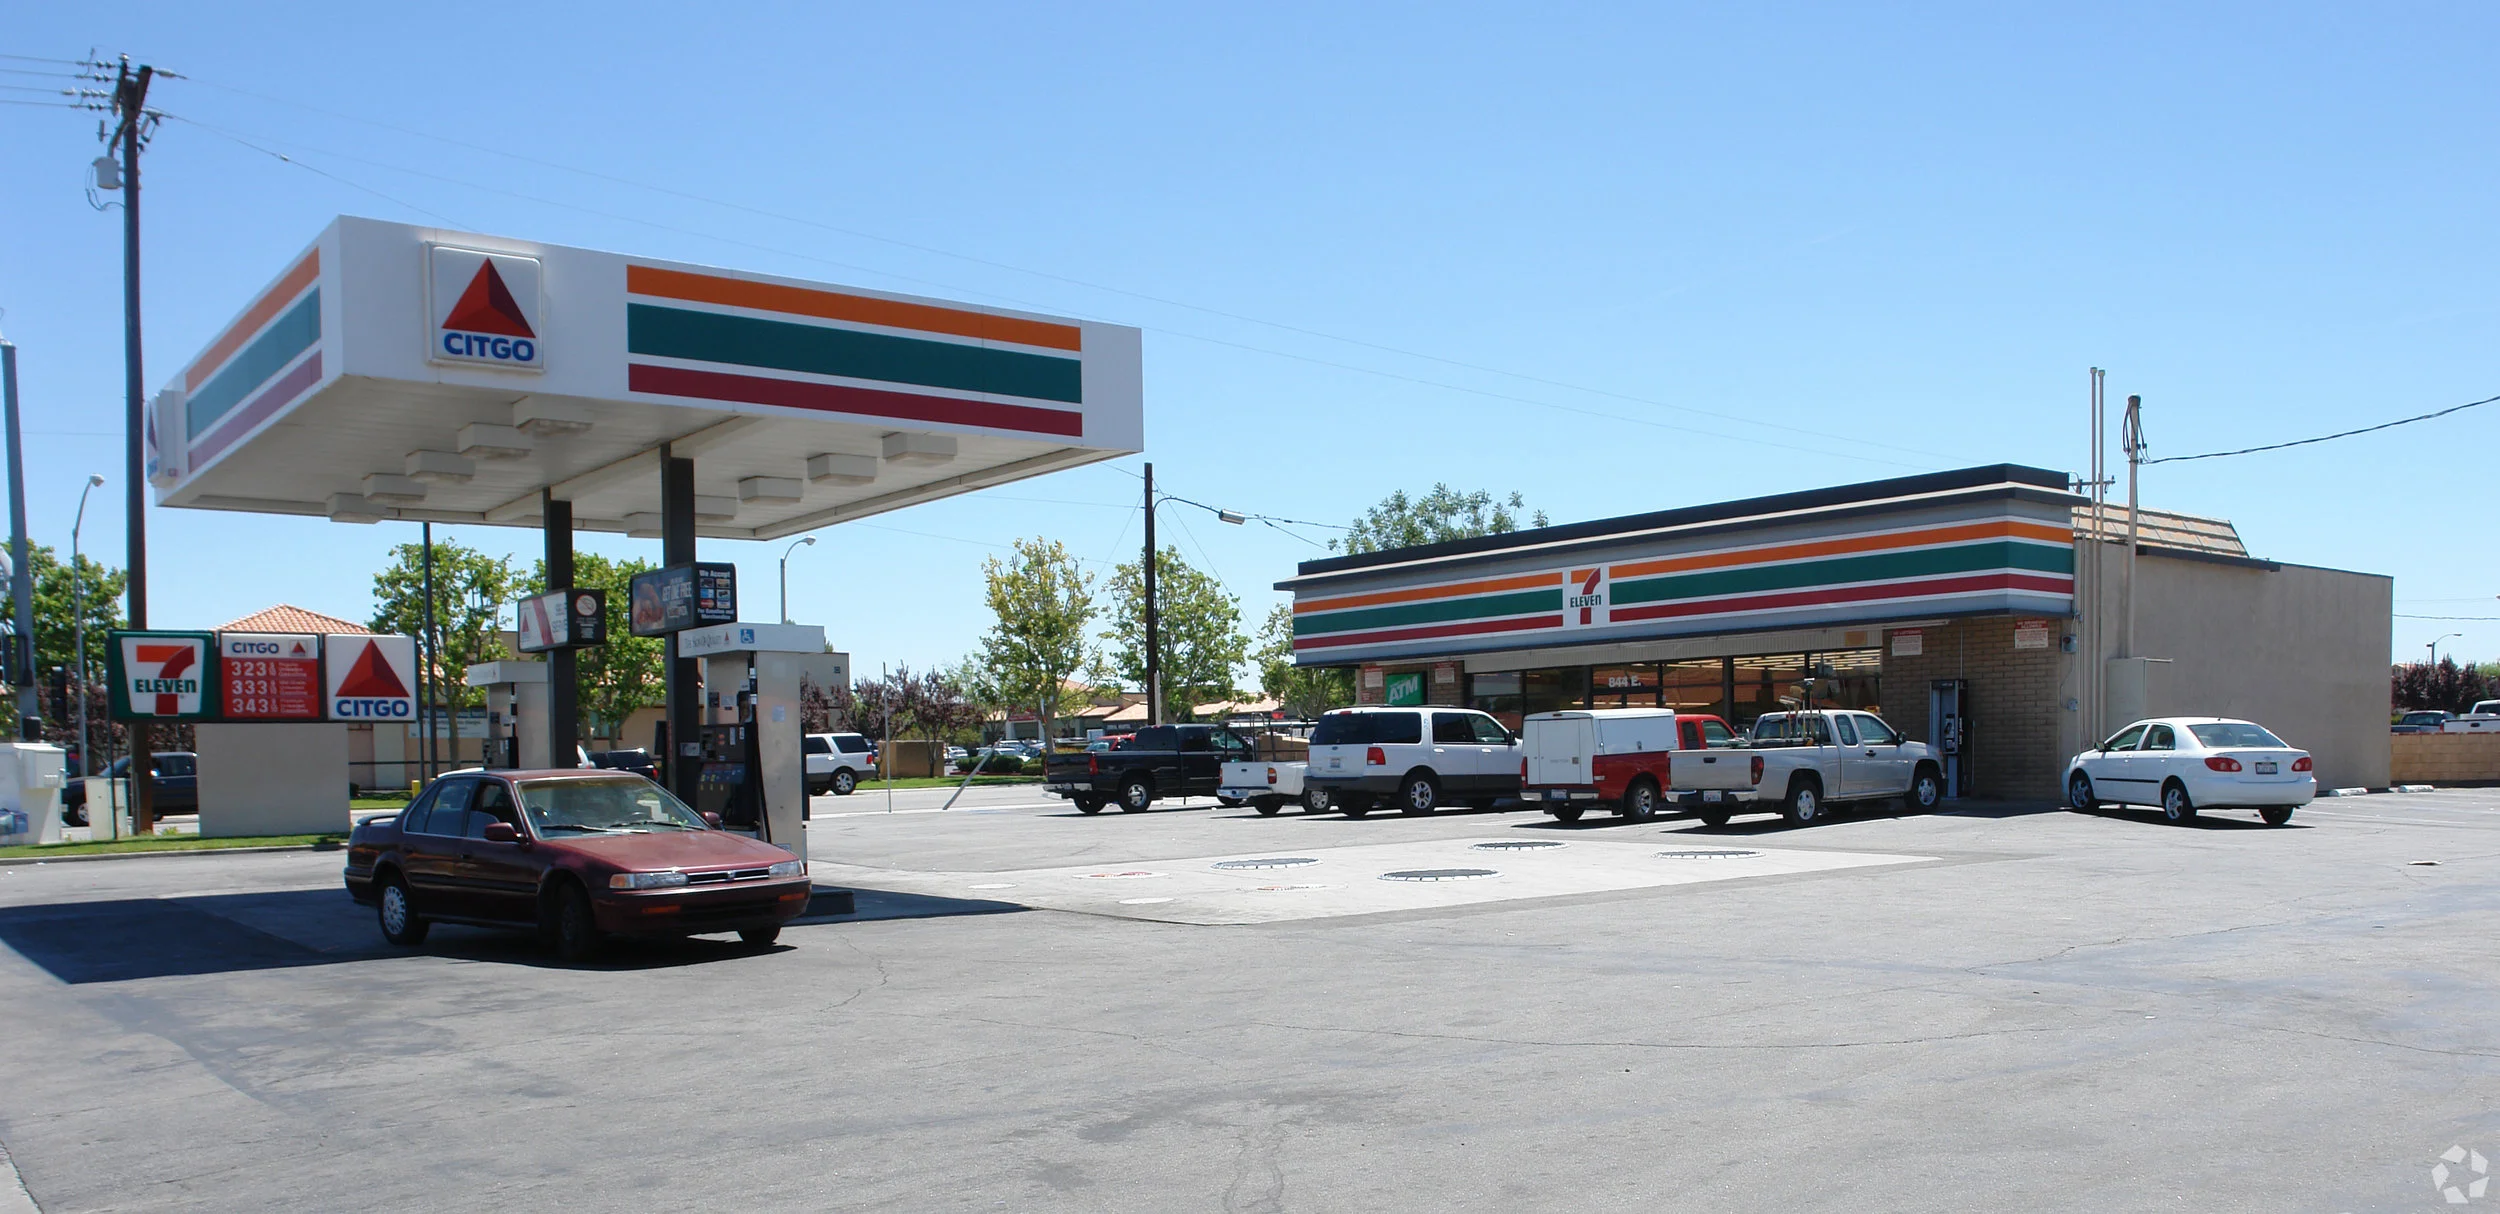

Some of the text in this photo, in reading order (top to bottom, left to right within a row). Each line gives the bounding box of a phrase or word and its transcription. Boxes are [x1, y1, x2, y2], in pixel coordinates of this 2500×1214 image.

[443, 332, 535, 361] CITGO
[231, 642, 279, 654] CITGO
[231, 661, 267, 676] 323
[136, 644, 195, 715] 7
[1608, 676, 1628, 688] 844
[232, 680, 268, 695] 333
[1388, 675, 1418, 704] ATM
[232, 698, 269, 713] 343
[336, 699, 409, 717] CITGO
